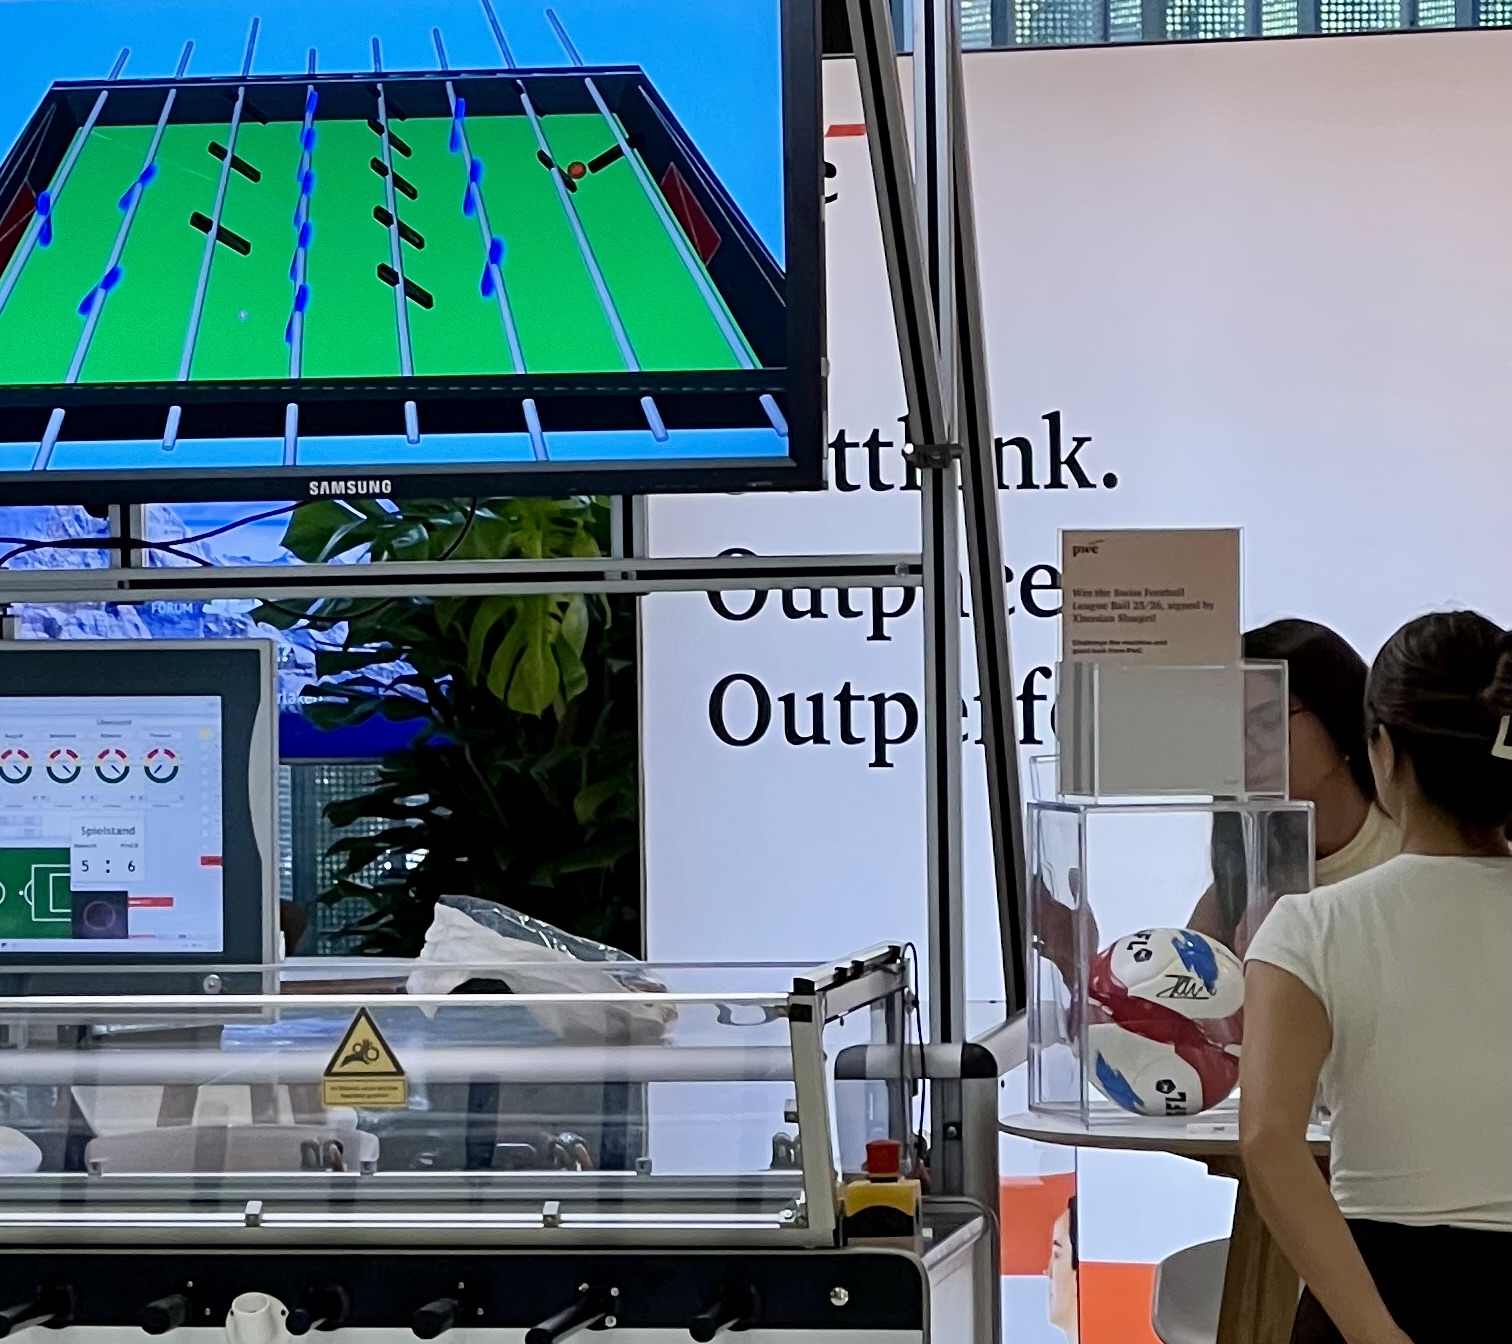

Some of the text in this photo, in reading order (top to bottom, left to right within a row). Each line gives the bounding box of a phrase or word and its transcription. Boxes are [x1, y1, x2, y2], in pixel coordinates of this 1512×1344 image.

[724, 410, 1119, 494] ttnk.
[309, 479, 392, 496] SAMSUNG
[708, 665, 1061, 768] Outpf
[81, 860, 89, 872] 5
[127, 860, 136, 872] 6
